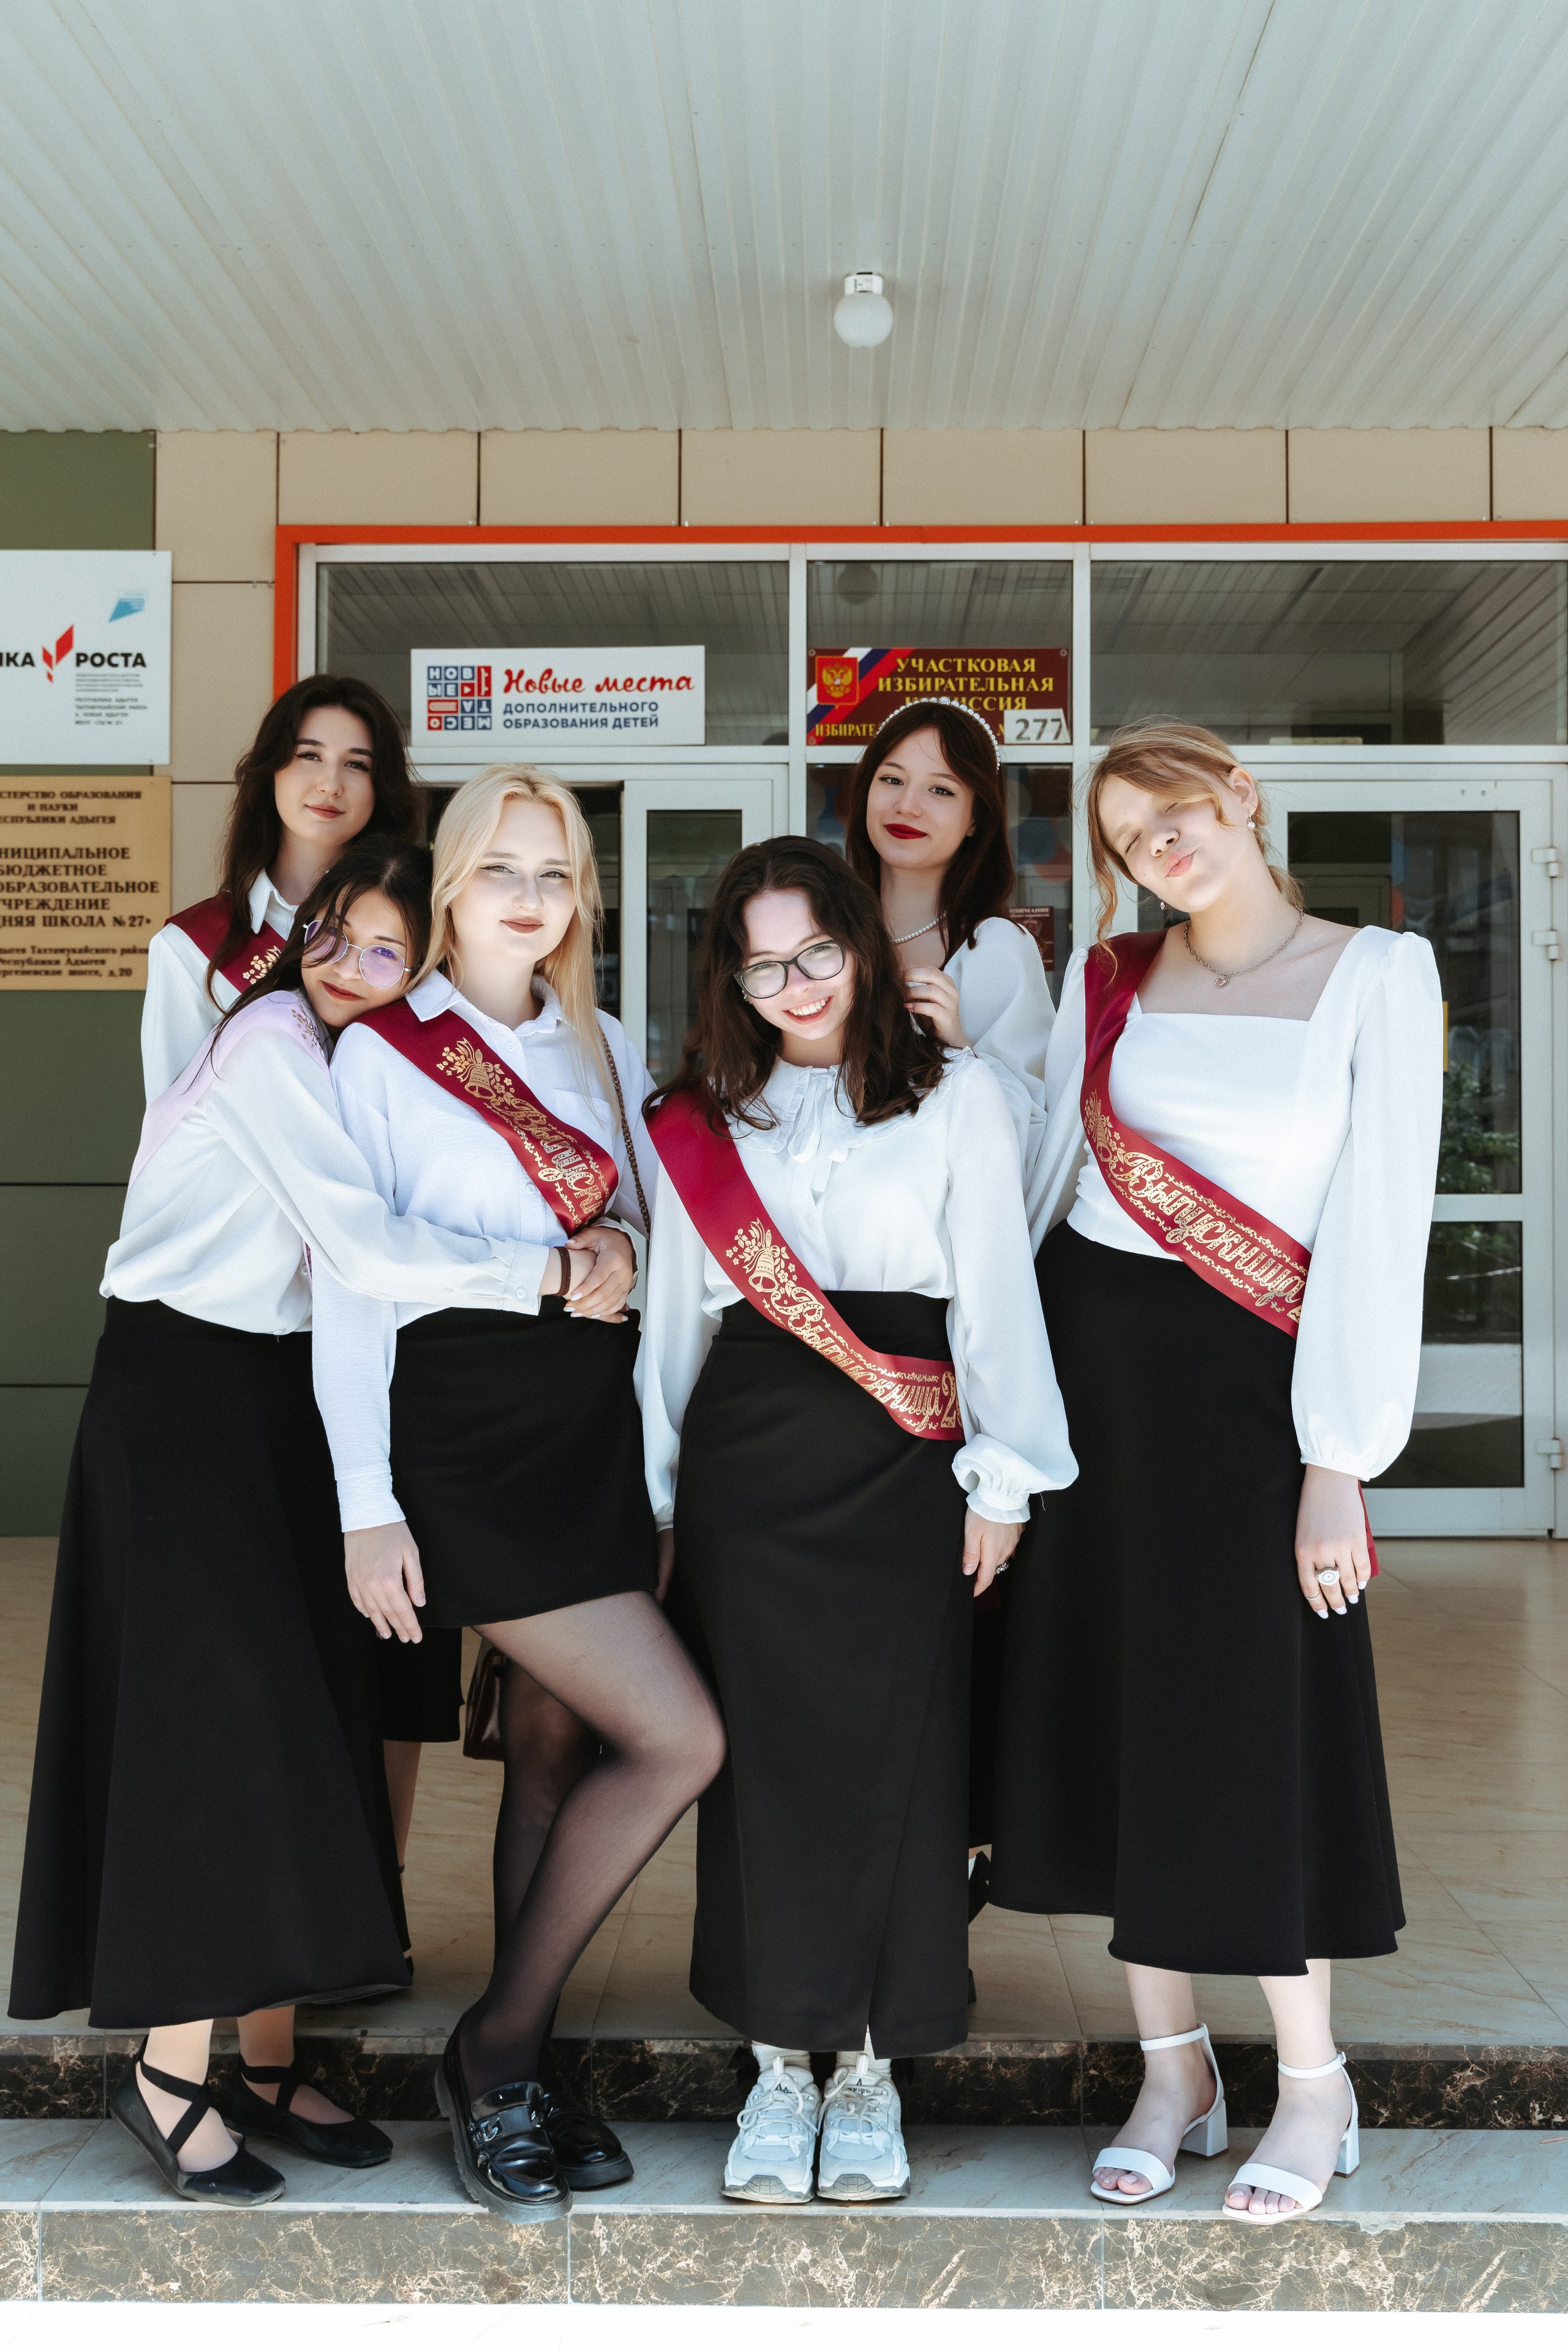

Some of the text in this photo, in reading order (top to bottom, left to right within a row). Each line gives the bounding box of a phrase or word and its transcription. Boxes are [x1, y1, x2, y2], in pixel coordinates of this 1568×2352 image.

[76, 652, 146, 668] РОСТА
[896, 658, 1036, 673] УЧАСТКОВАЯ
[503, 668, 695, 694] Новые места
[878, 677, 1054, 692] ИЗБИРАТЕЛЬНАЯ
[503, 701, 659, 715] ДОПОЛНИТЕЛЬНОГО
[503, 714, 659, 729] ОБРАЗОВАНИЯ ДЕТЕЙ
[1015, 718, 1063, 741] 277
[60, 791, 141, 799] ОБРАЗОВАНИЯ
[70, 816, 116, 824] АДЫГЕЯ
[0, 898, 110, 911] ЧРЕЖДЕНИЕ
[0, 916, 36, 927] НЯЯ
[42, 916, 105, 928] ШКОЛА
[1108, 1150, 1306, 1307] Выпускница
